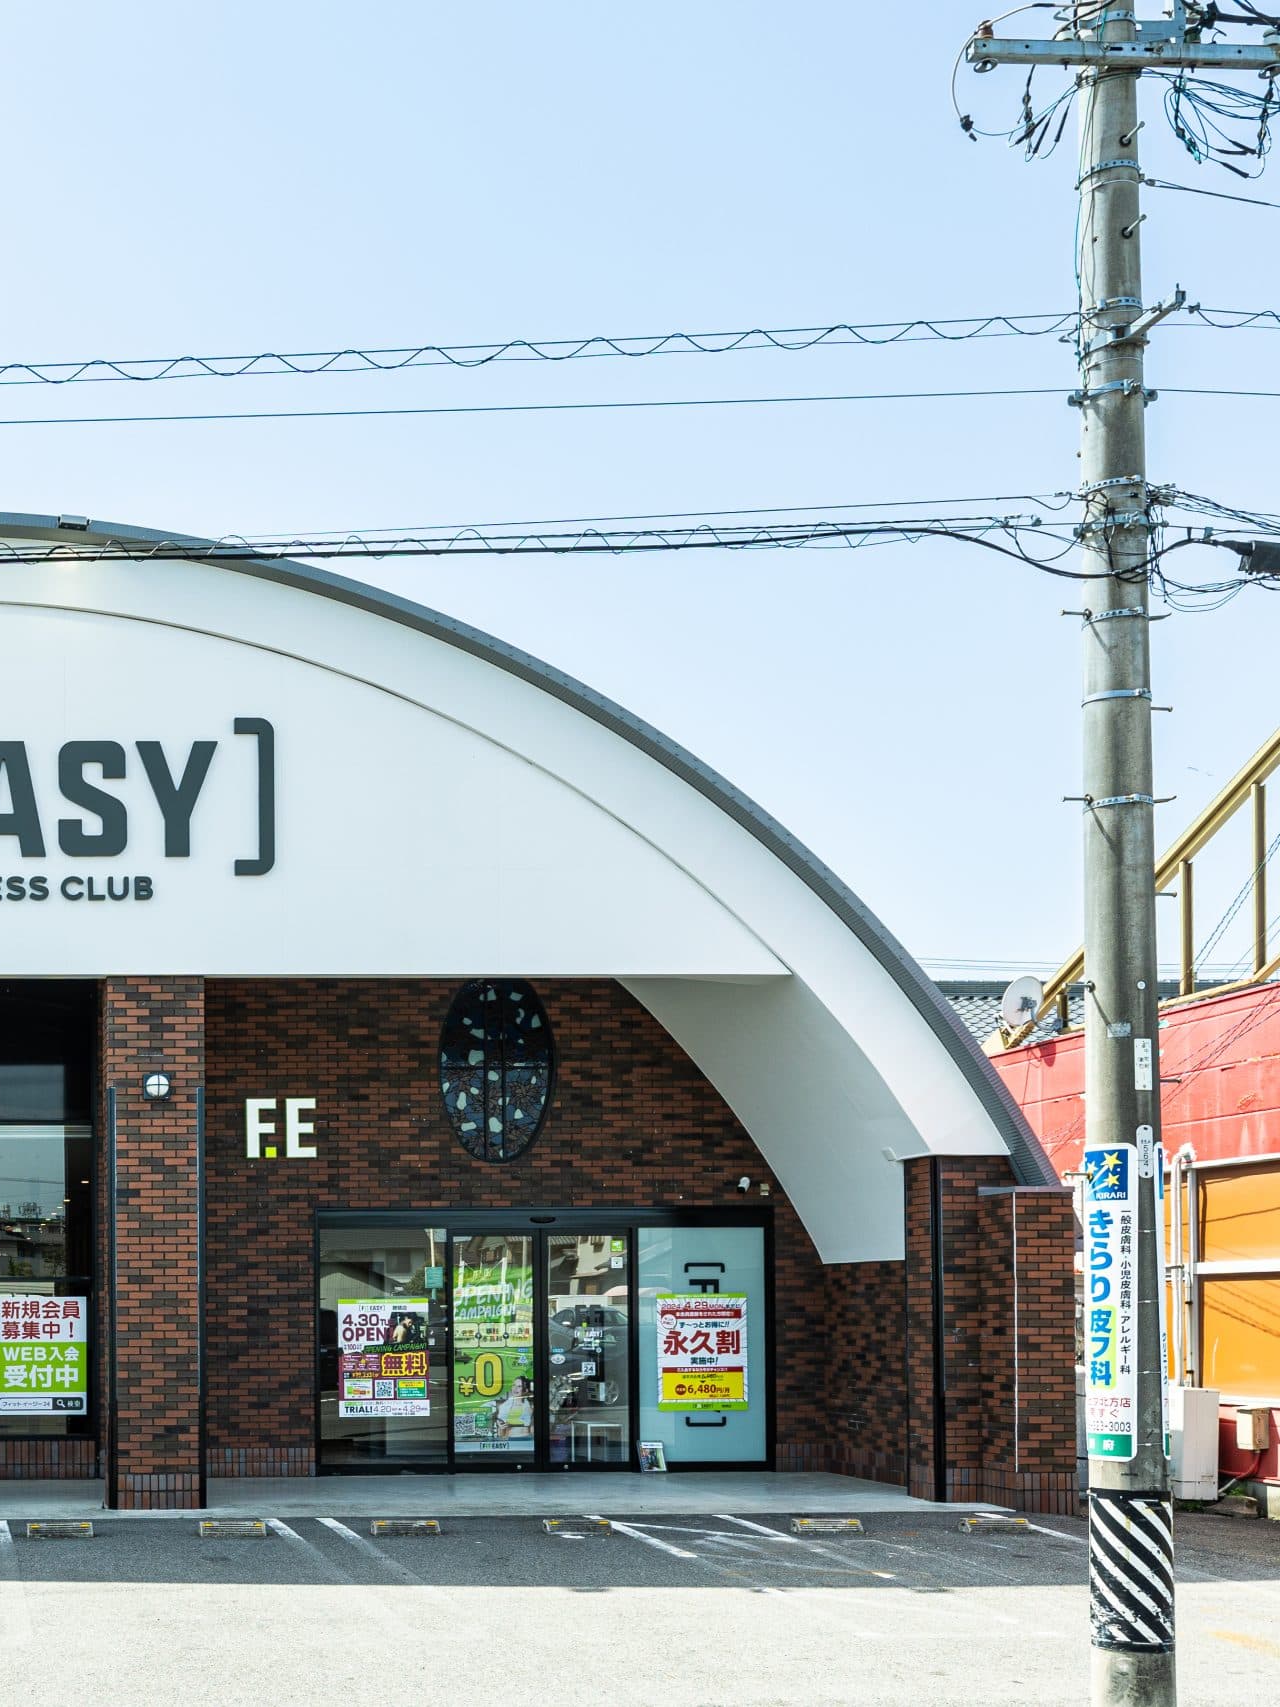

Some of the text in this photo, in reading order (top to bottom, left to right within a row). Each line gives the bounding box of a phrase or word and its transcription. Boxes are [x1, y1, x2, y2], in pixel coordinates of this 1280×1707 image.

[60, 876, 155, 901] CLUB
[1095, 1191, 1127, 1200] KIRARI
[1, 1301, 81, 1319] 新規会員
[1088, 1209, 1114, 1387] きらり皮フ科
[663, 1330, 741, 1356] 永久割
[3, 1364, 79, 1389] 受付中
[381, 1352, 428, 1376] 無料
